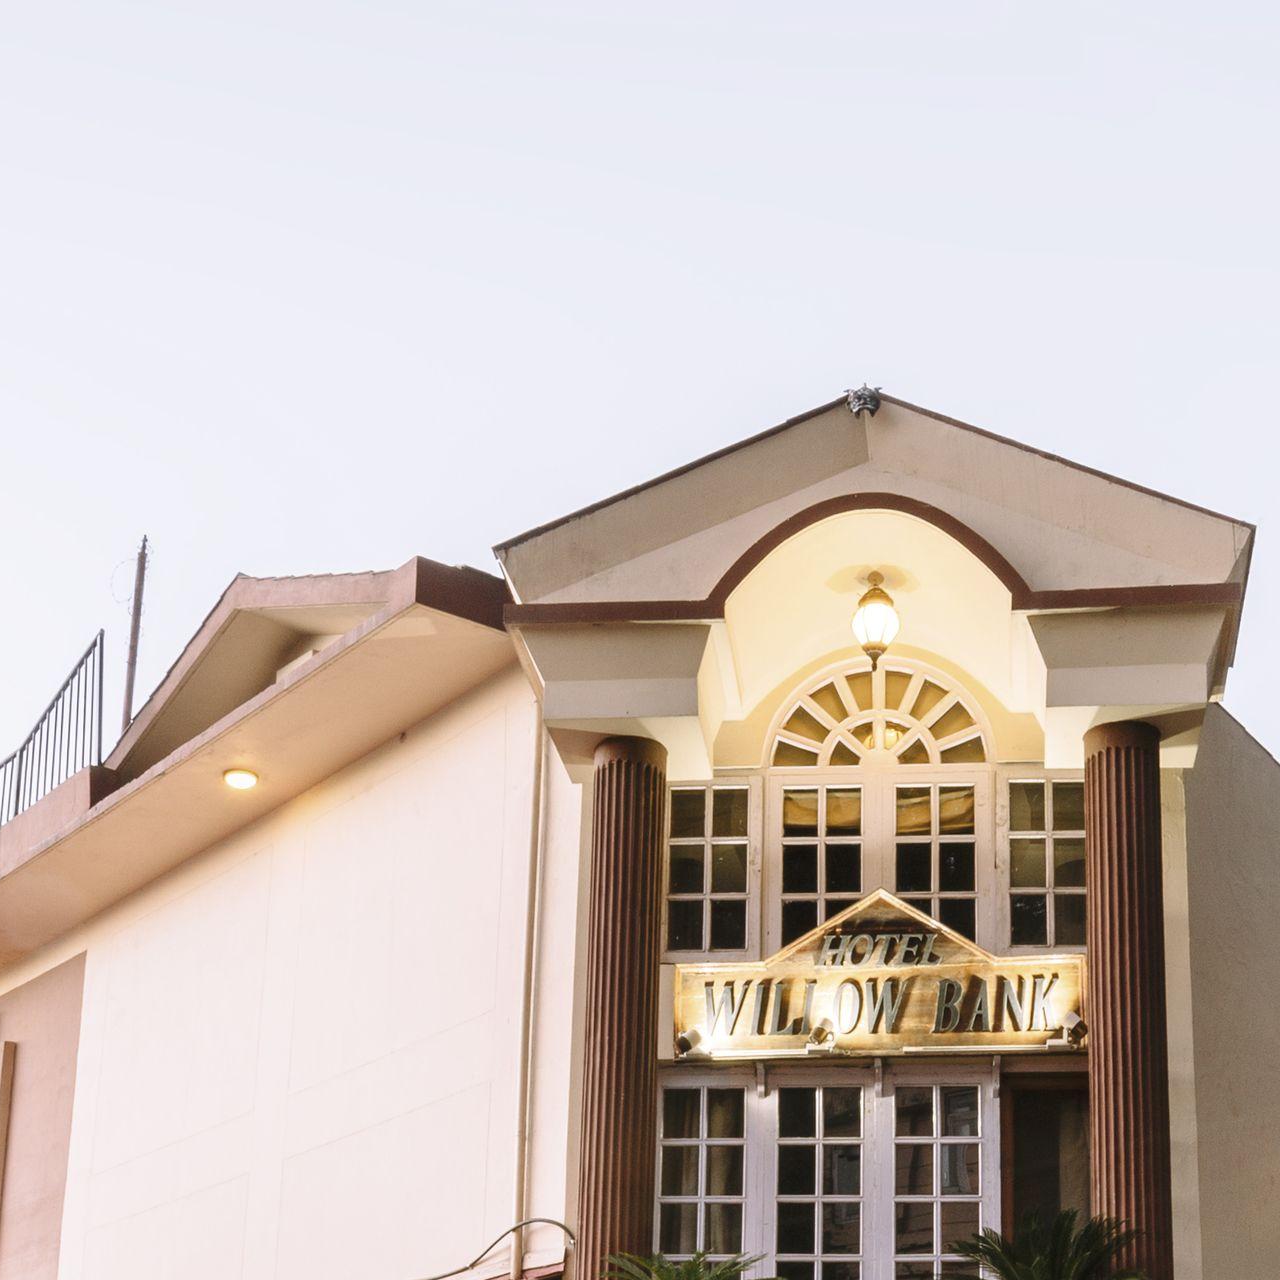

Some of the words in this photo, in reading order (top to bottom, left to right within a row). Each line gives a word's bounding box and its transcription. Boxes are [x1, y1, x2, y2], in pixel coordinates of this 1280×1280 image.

[819, 934, 942, 966] HOTEL
[704, 979, 909, 1036] WILLOW
[931, 976, 1060, 1034] BANK
